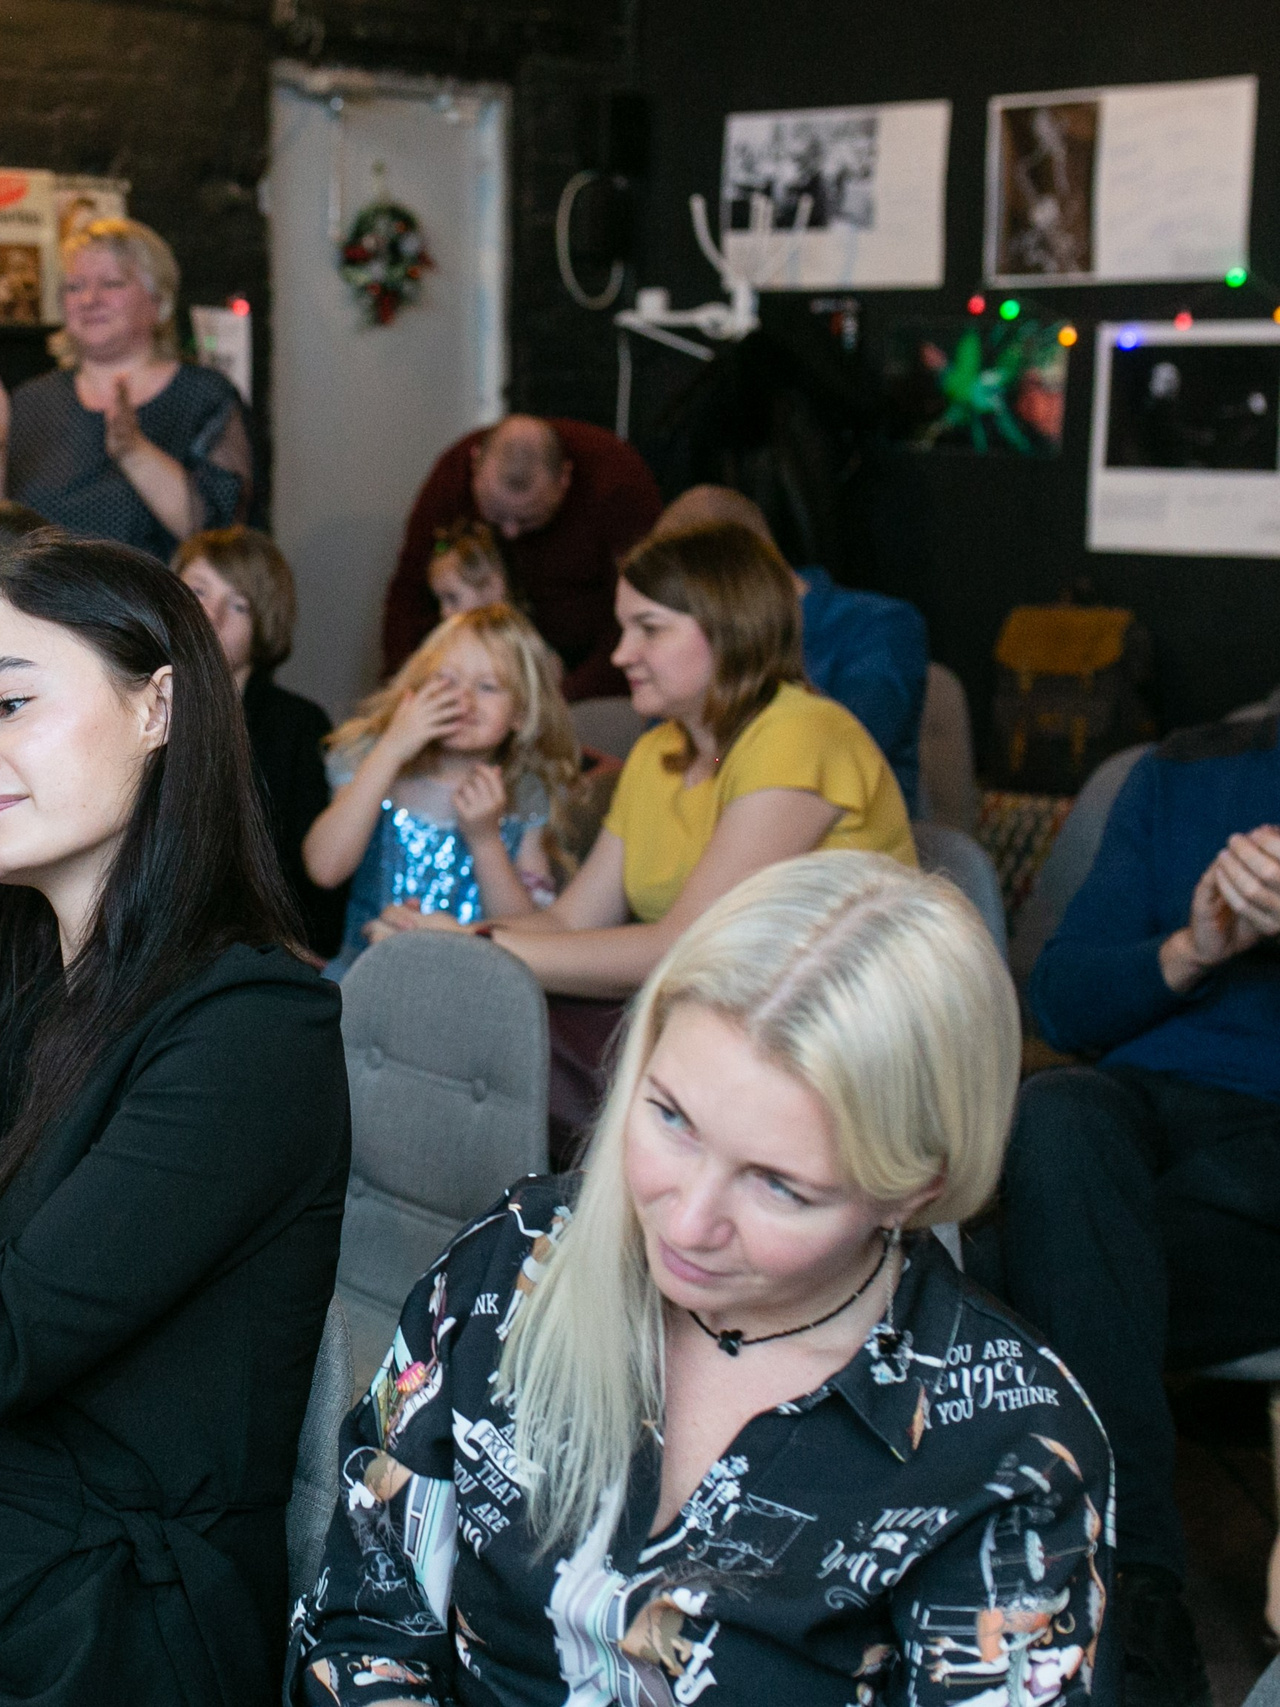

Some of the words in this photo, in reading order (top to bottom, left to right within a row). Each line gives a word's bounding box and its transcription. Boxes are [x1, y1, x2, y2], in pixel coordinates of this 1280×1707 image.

[946, 1344, 973, 1366] OU
[982, 1338, 1023, 1360] ARE
[935, 1398, 975, 1425] YOU
[993, 1385, 1060, 1412] THINK
[476, 1459, 521, 1506] THAT
[472, 1502, 511, 1533] ARE
